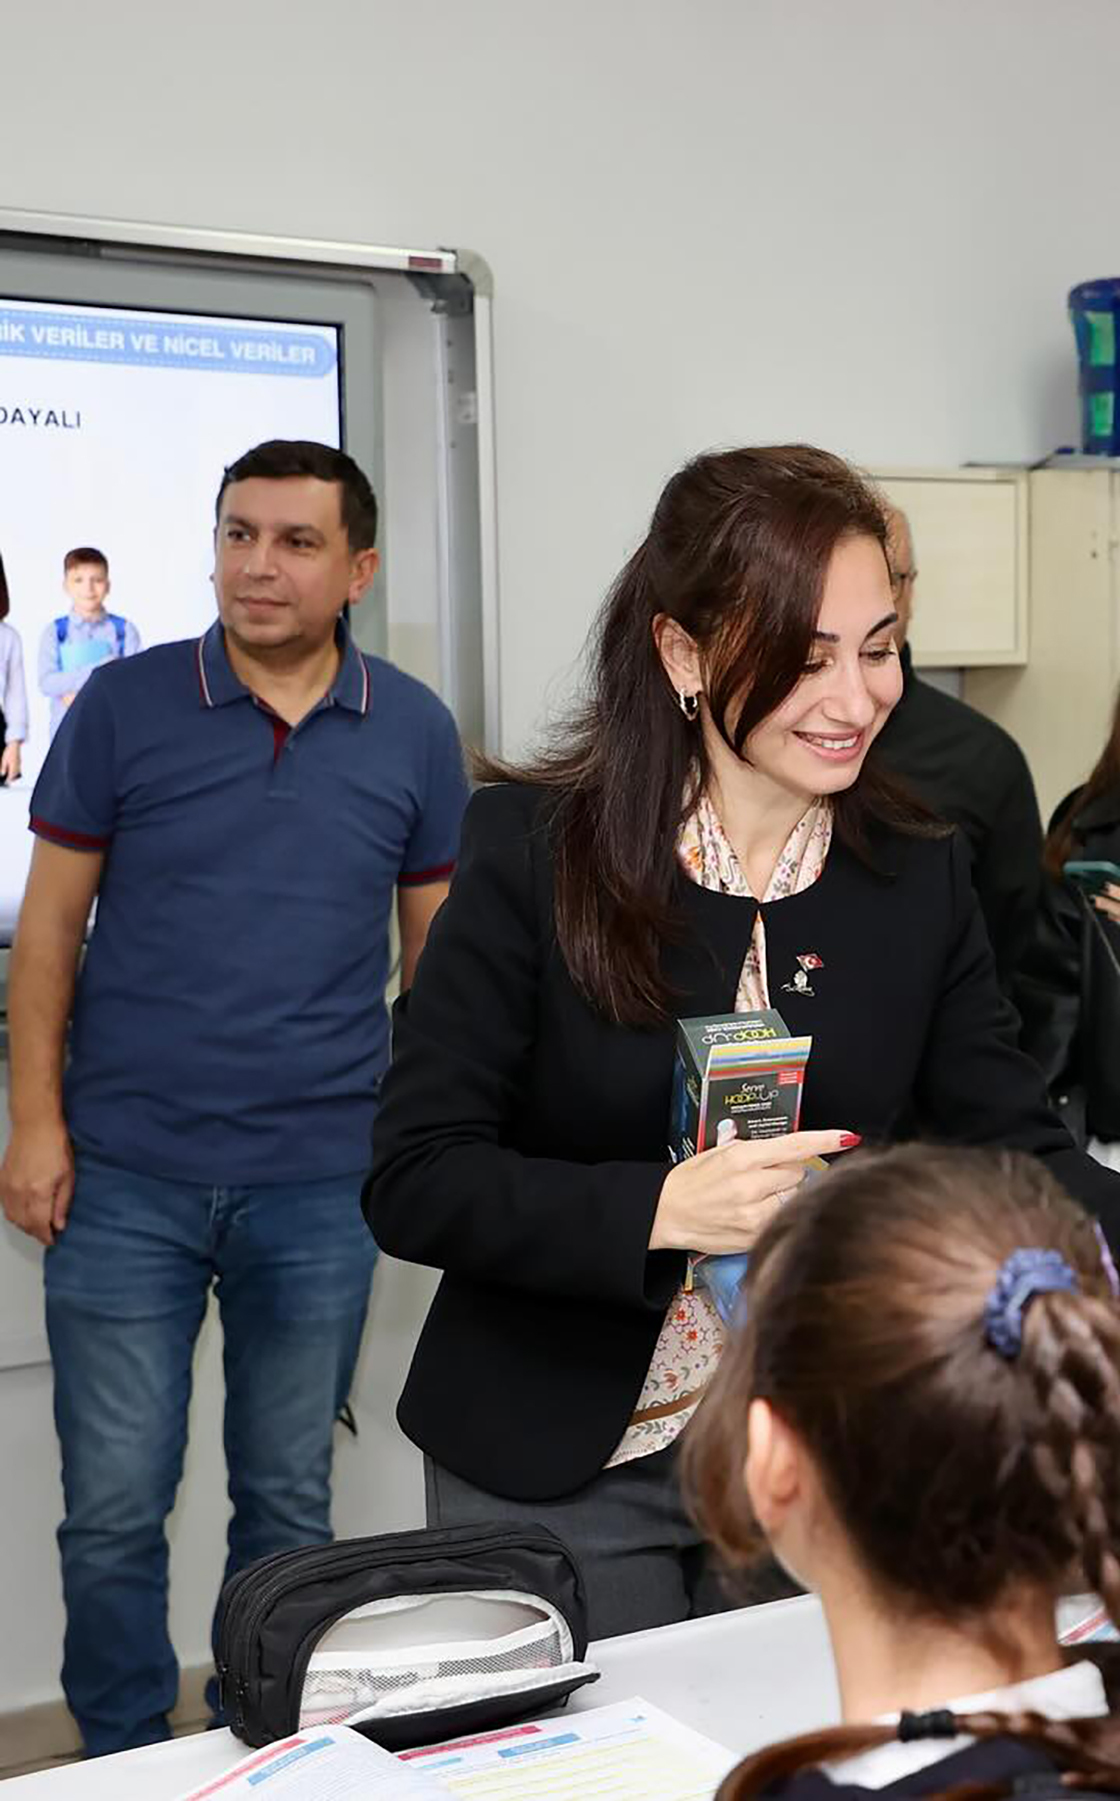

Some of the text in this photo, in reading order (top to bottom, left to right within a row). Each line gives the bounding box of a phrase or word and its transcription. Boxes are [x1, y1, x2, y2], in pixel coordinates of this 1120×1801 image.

[0, 319, 316, 364] İK VERİLER VE NİCEL VERİLER
[0, 406, 82, 430] DAYALI
